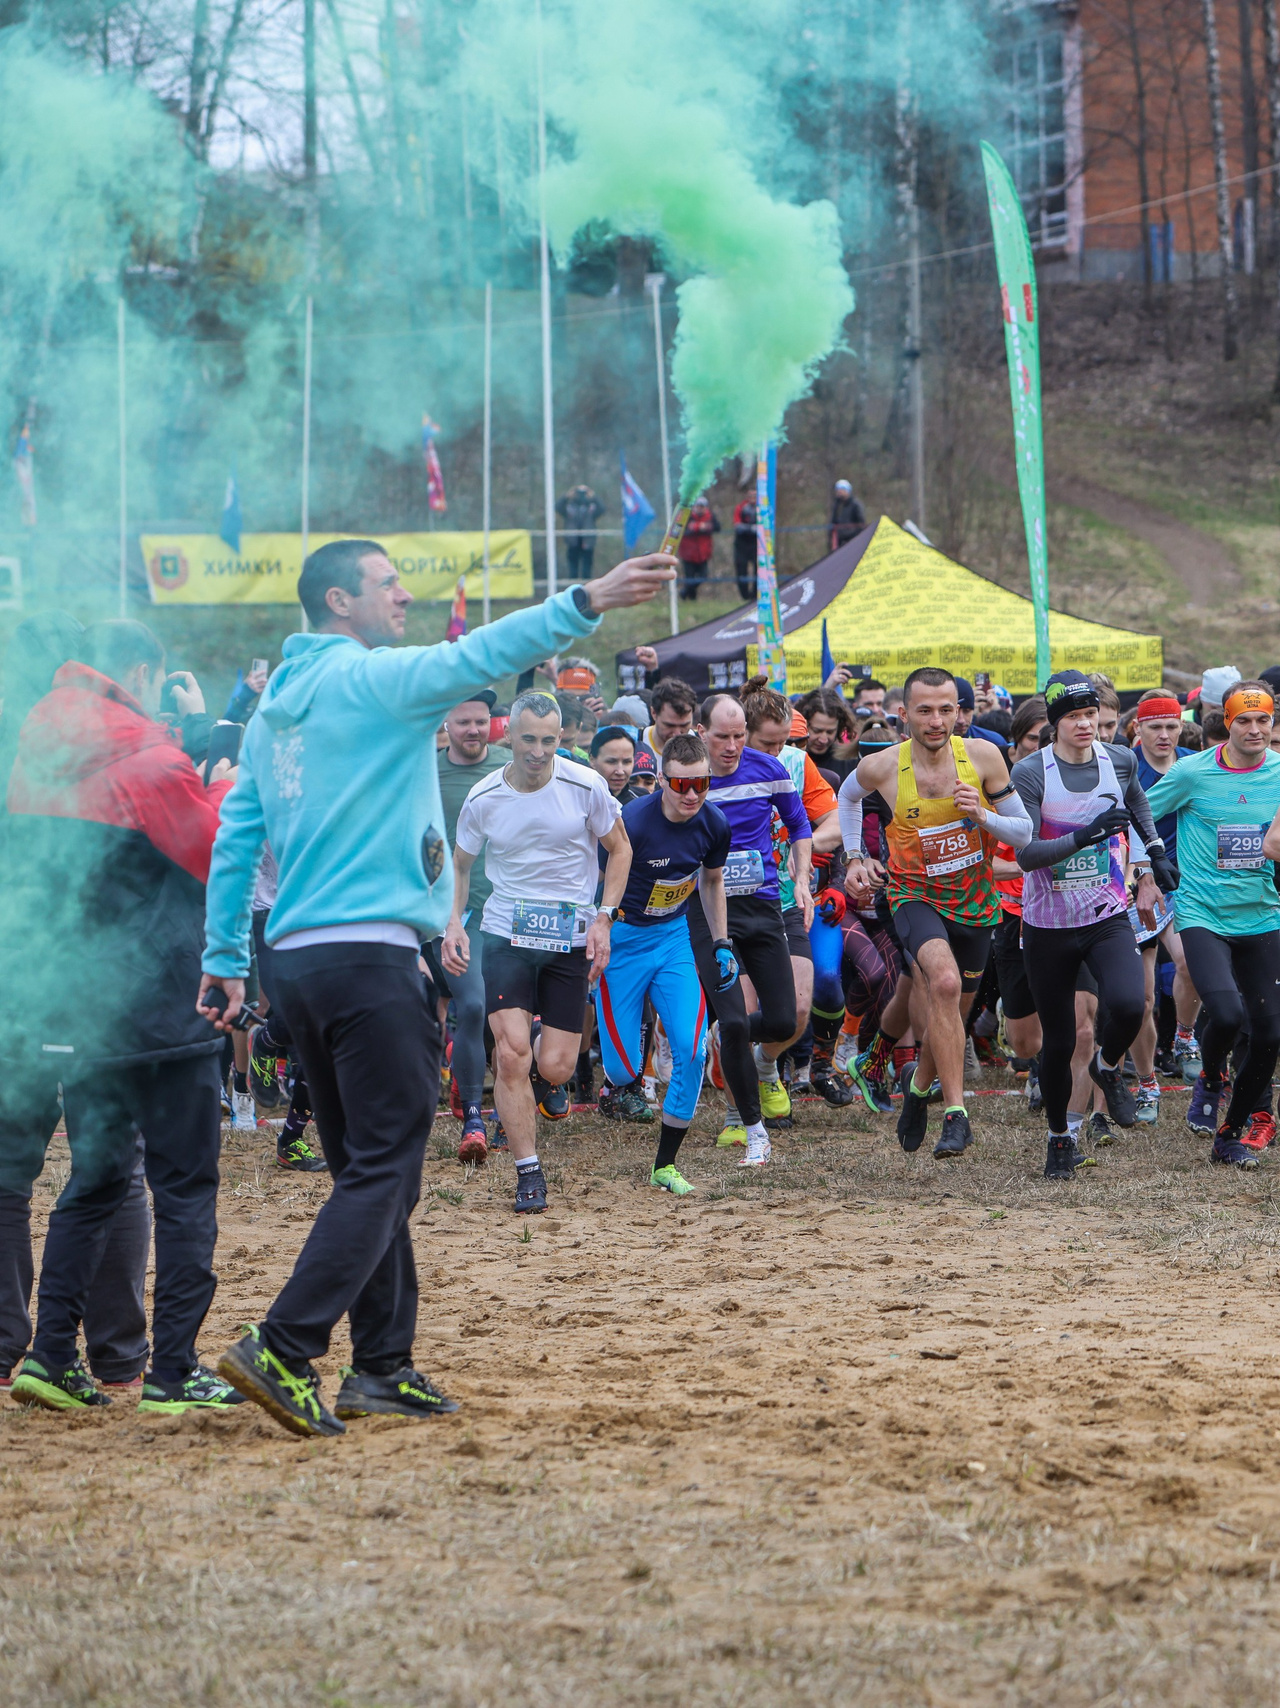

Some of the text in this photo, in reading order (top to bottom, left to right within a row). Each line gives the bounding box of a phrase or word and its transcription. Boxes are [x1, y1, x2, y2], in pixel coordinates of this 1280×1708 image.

[203, 559, 281, 577] ХИМКИ
[935, 833, 969, 855] 758
[1231, 836, 1262, 851] 299
[721, 864, 751, 879] 252
[1065, 855, 1098, 871] 463
[664, 884, 689, 902] 916
[527, 912, 560, 931] 301
